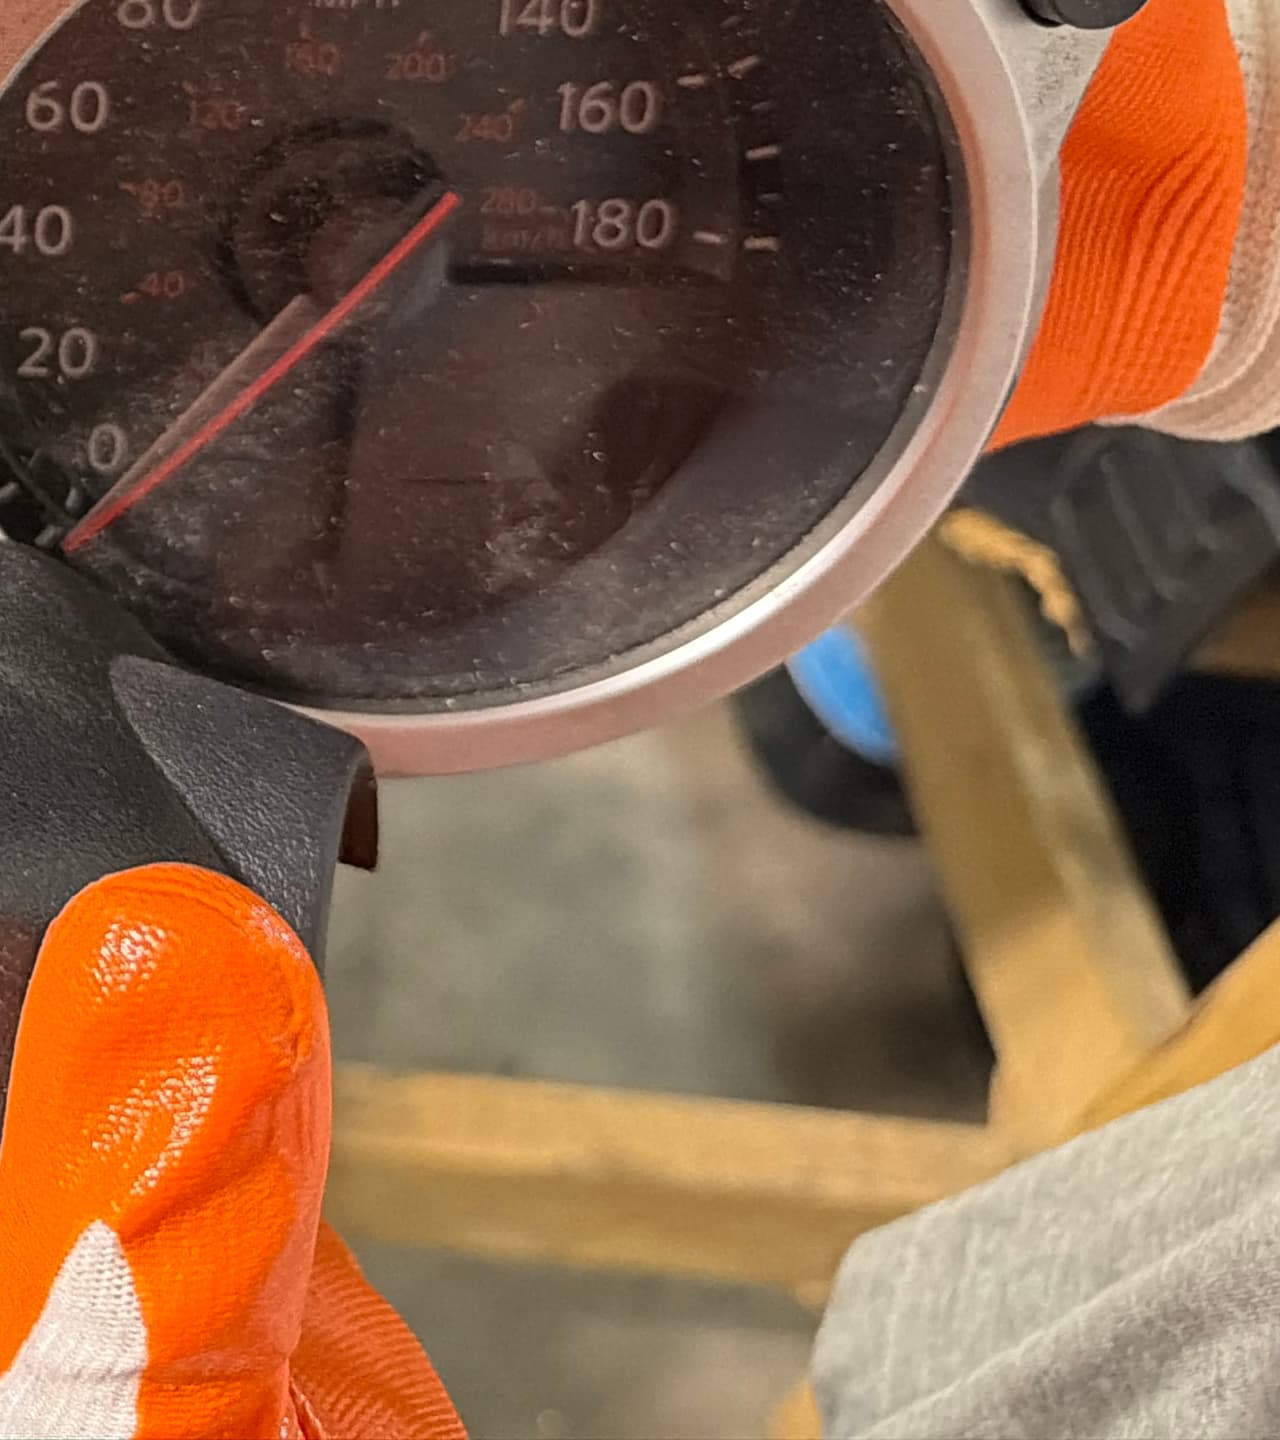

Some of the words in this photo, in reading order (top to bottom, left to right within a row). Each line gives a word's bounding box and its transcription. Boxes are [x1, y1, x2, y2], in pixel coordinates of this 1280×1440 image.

[25, 80, 109, 133] 60
[557, 80, 658, 135] 160
[571, 197, 672, 250] 180
[138, 270, 187, 299] 40
[17, 327, 97, 378] 20
[87, 423, 127, 472] 0
